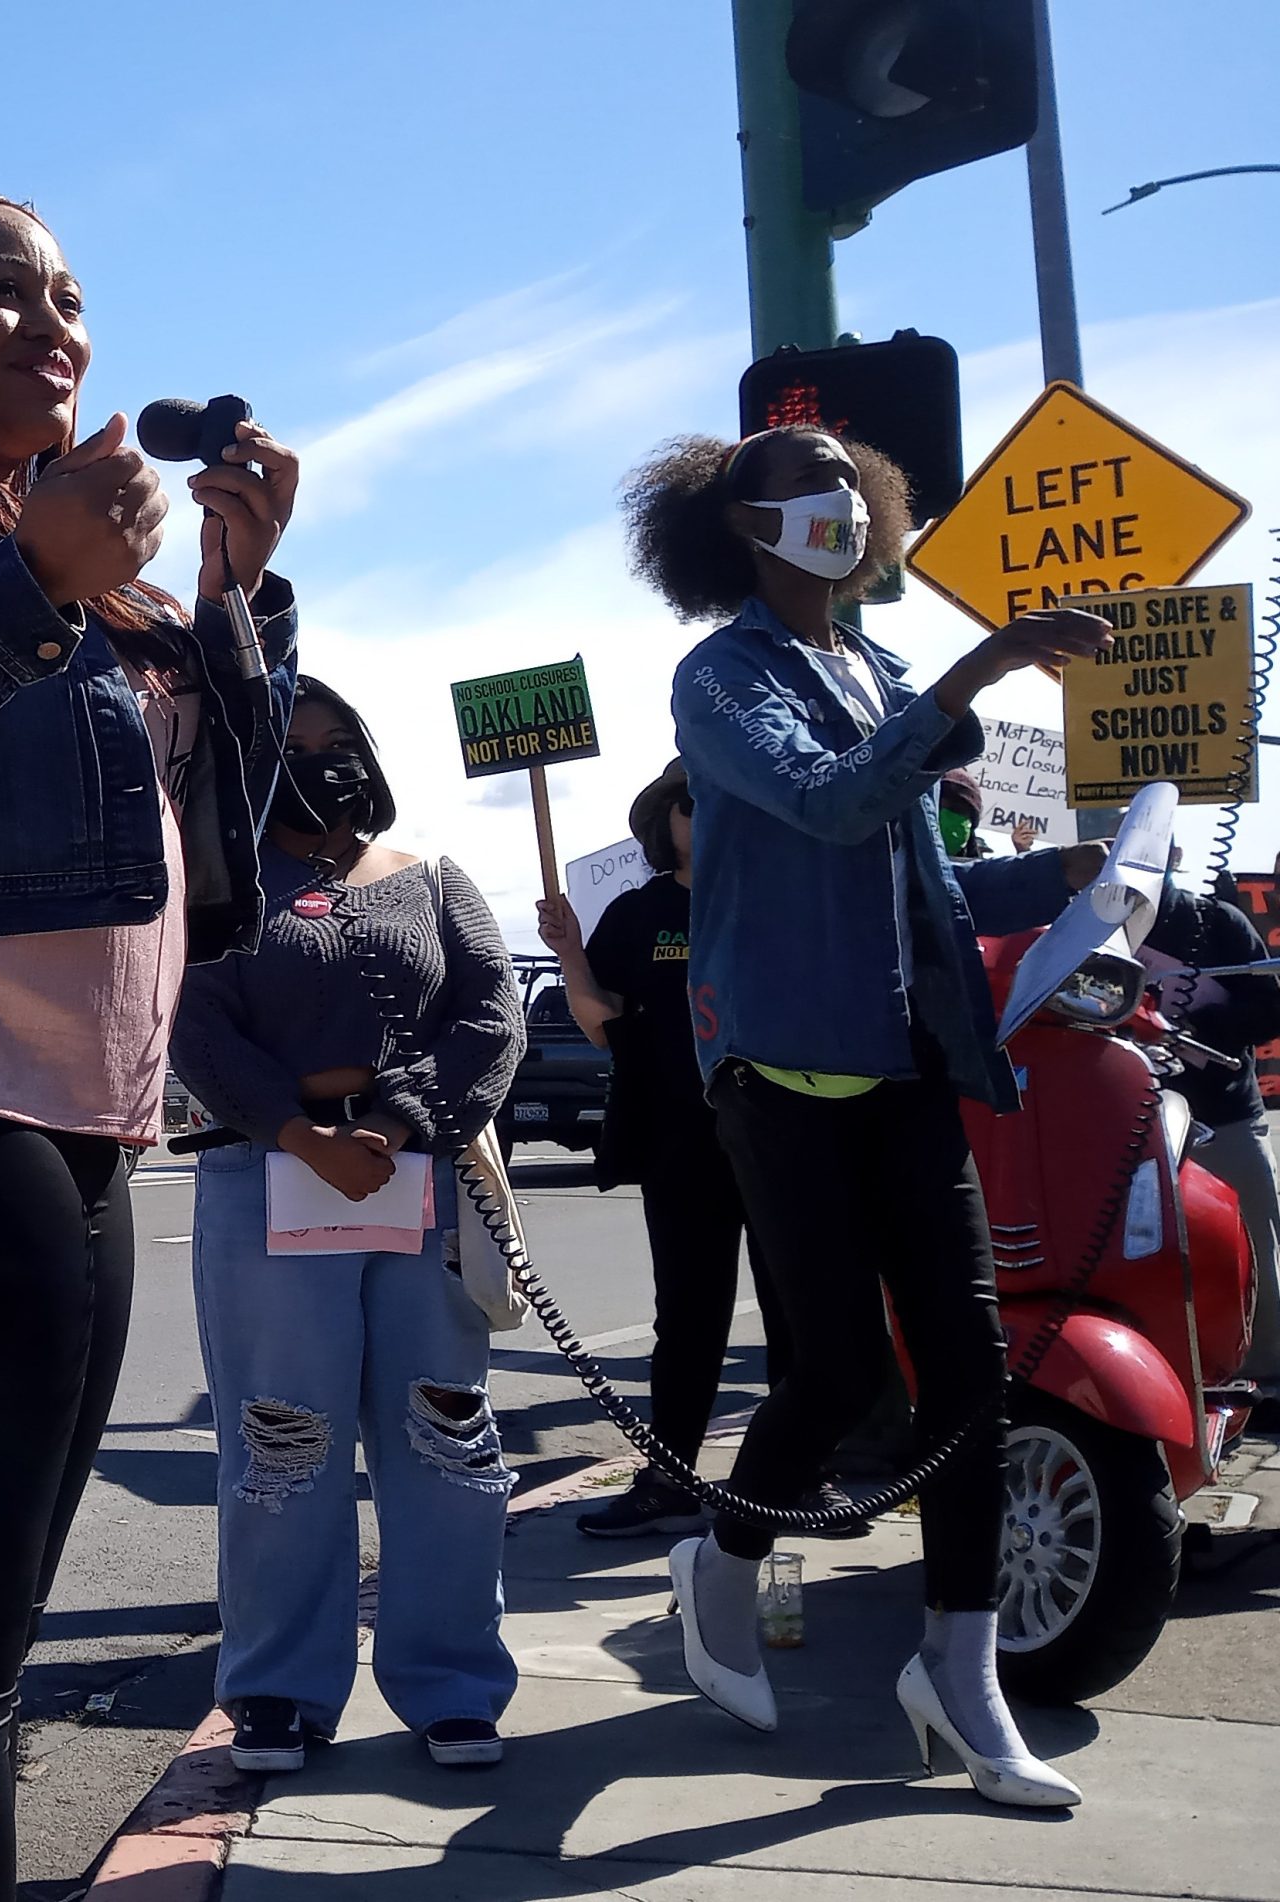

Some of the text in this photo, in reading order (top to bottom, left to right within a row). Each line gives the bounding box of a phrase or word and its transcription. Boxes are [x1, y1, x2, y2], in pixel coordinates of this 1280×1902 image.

[1004, 456, 1131, 516] LEFT
[1001, 514, 1142, 574] LANE
[1070, 595, 1238, 631] ND SAFE &
[456, 665, 583, 703] NO SCHOOL CLOSURES!
[1124, 665, 1189, 697] JUST
[459, 684, 588, 739] OAKLAND
[1091, 703, 1228, 742] SCHOOLS
[466, 722, 593, 766] NOT FOR SALE
[995, 720, 1028, 741] Not
[1120, 743, 1201, 778] NOW!
[976, 767, 1019, 794] tance
[1026, 775, 1066, 800] Lear
[655, 946, 685, 959] NOT
